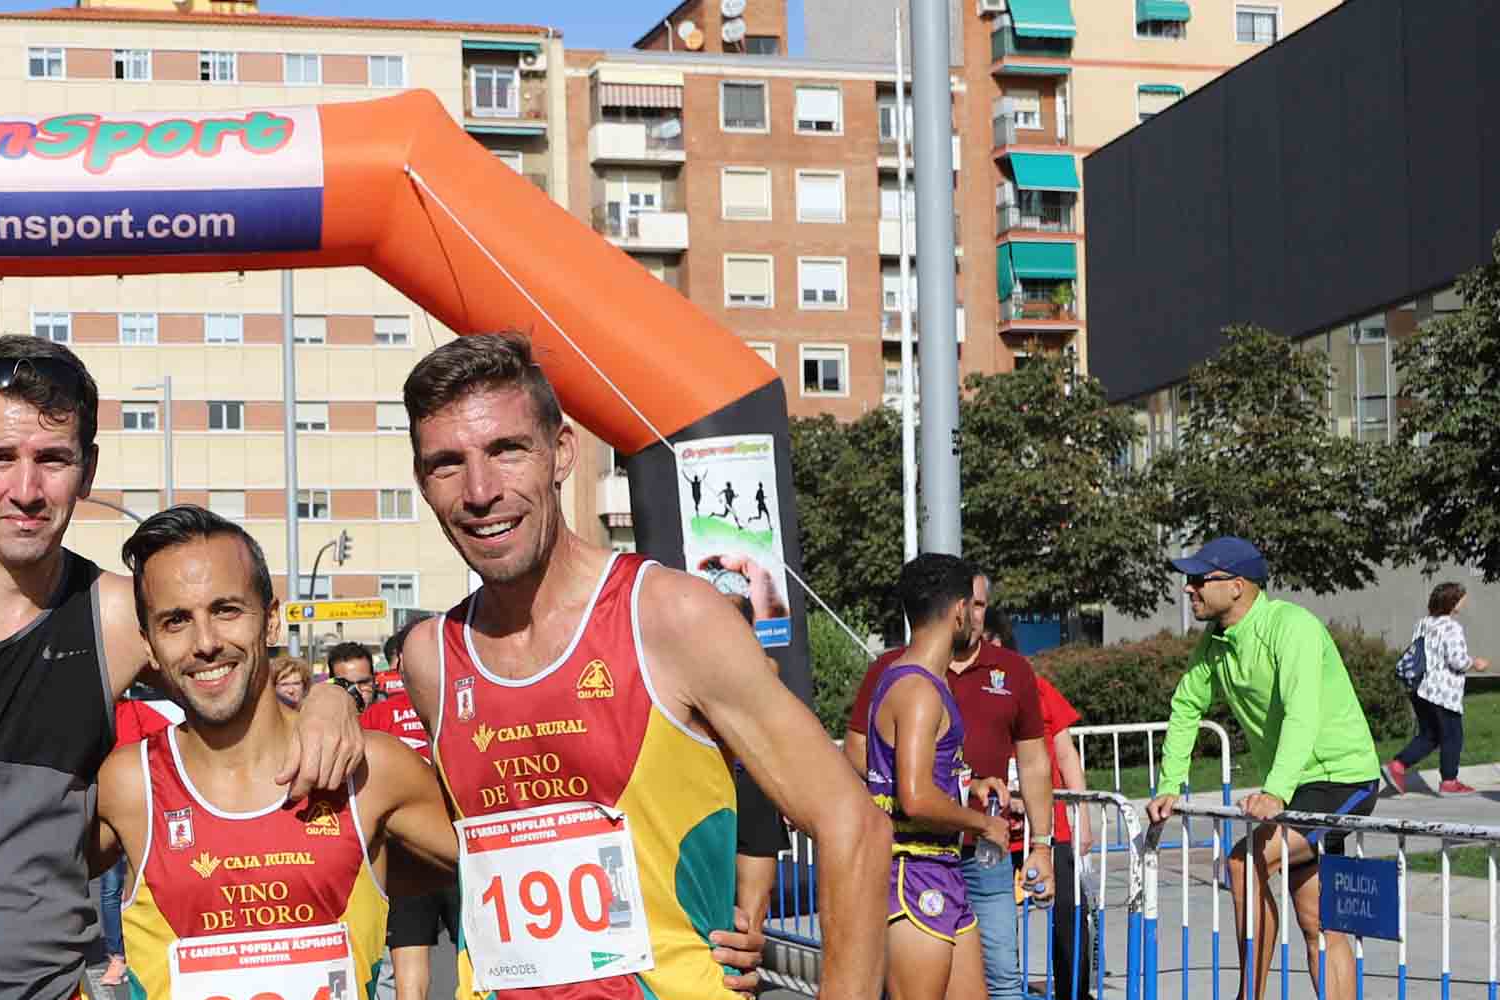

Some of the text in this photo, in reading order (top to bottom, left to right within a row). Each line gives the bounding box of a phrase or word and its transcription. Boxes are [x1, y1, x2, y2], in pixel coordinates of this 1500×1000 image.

[577, 688, 614, 699] austral
[497, 719, 587, 741] CAJA RURAL
[493, 752, 560, 779] VINO
[480, 776, 589, 808] DE TORO
[223, 852, 315, 870] CAJA RURAL
[220, 881, 288, 904] VINO
[1334, 872, 1378, 895] POLICIA
[482, 863, 613, 944] 190
[1337, 896, 1375, 918] LOCAL
[202, 904, 314, 931] DE TORO
[240, 940, 290, 954] POPULAR
[292, 935, 343, 950] ASPRODES
[489, 963, 537, 976] ASPRODES
